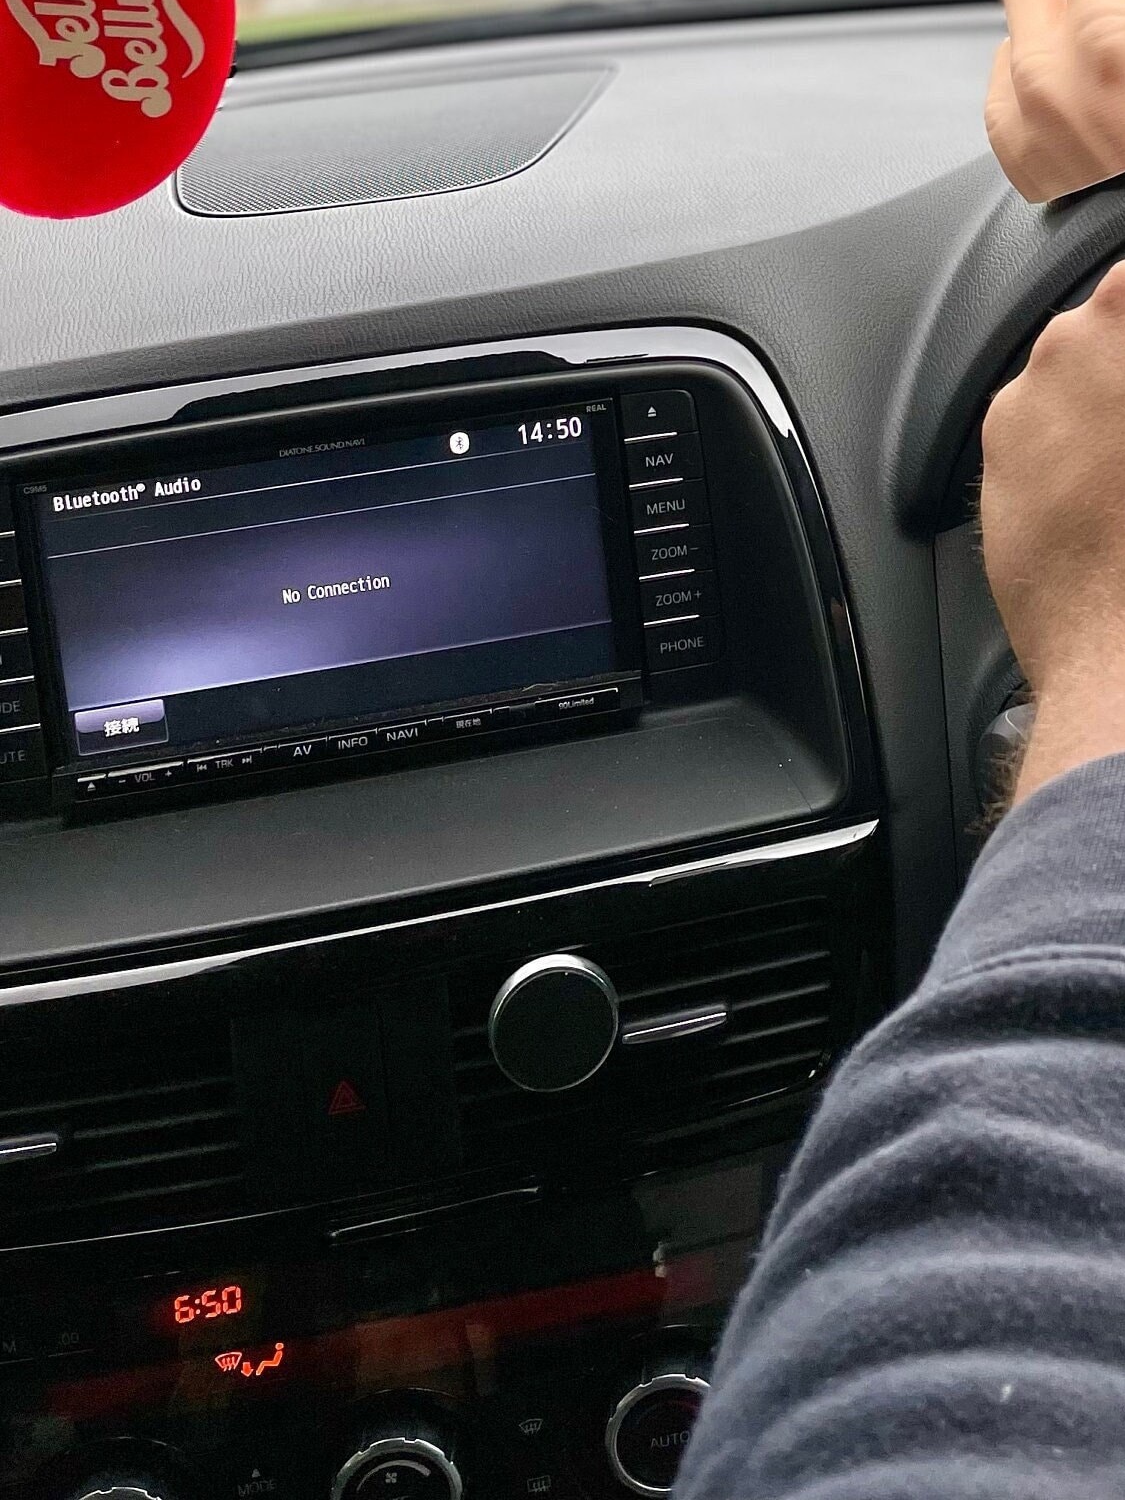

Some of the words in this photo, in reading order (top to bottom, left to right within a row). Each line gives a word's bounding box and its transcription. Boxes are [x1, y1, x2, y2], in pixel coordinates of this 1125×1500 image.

[585, 403, 607, 414] REAL
[517, 416, 582, 446] 14:50
[645, 453, 675, 468] NAV
[154, 476, 202, 499] Audio
[646, 498, 686, 516] MENU
[282, 588, 301, 604] No
[307, 574, 391, 601] Connection
[659, 635, 705, 655] PHONE
[103, 718, 140, 737] 接続
[386, 727, 419, 743] NAVI
[292, 743, 313, 757] AV
[336, 735, 369, 750] INFO
[214, 759, 234, 770] TRK
[134, 772, 156, 784] VOL
[174, 1285, 243, 1324] 6:50
[650, 1430, 690, 1450] AUTO
[237, 1478, 276, 1497] MODE
